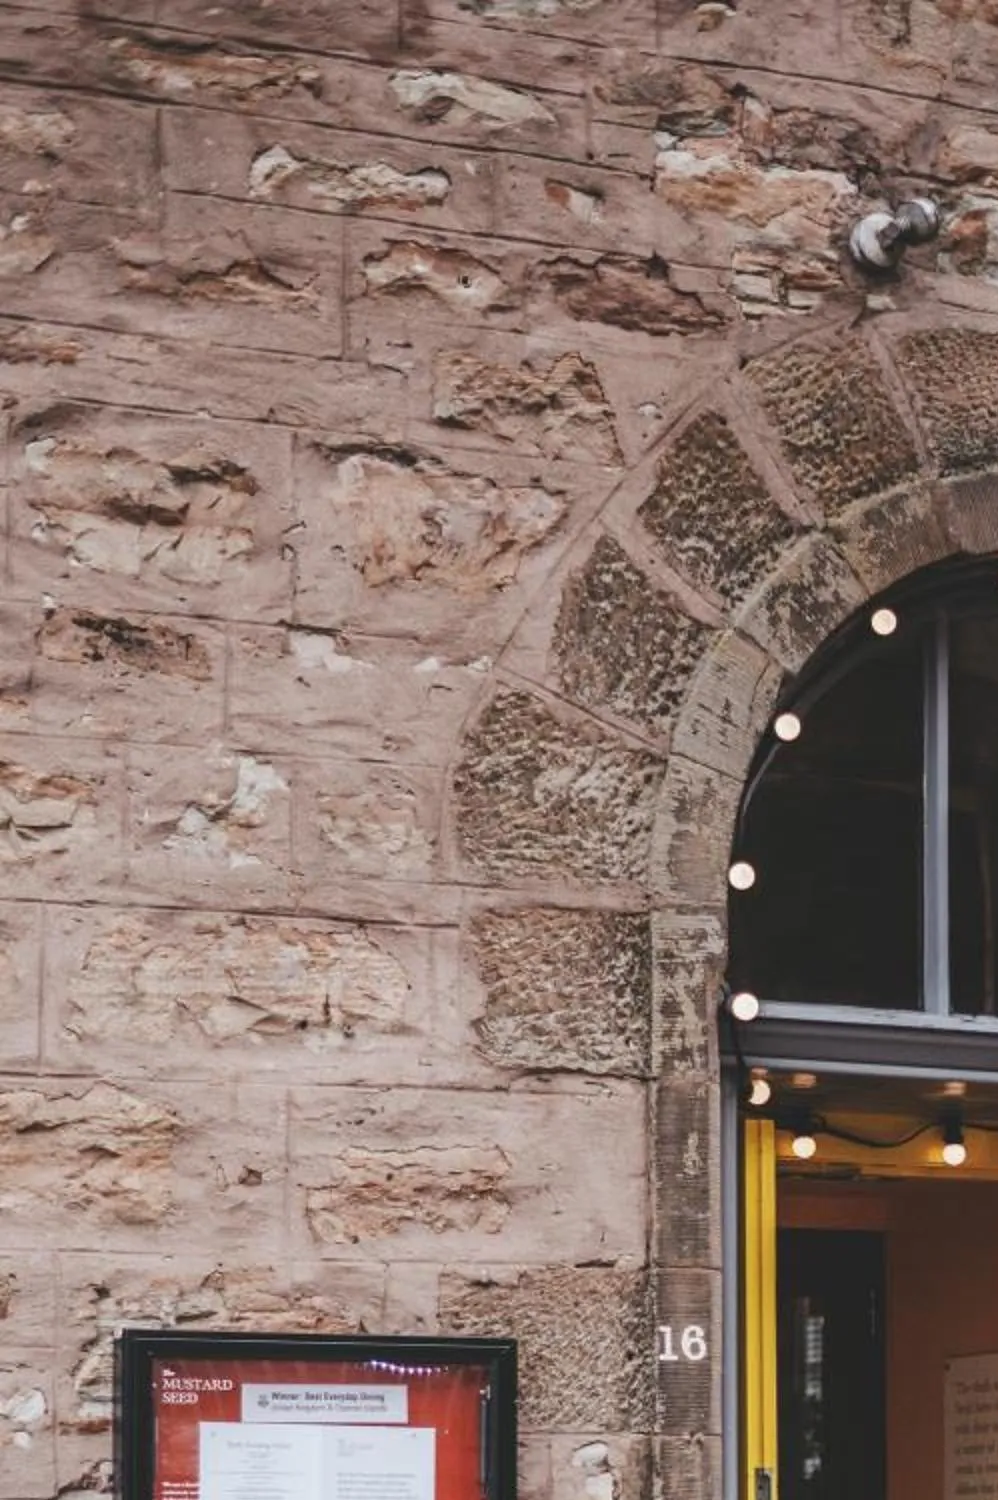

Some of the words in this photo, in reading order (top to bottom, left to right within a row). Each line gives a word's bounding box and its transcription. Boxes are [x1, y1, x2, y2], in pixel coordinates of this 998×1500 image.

[659, 1325, 707, 1361] 16
[162, 1378, 233, 1391] MUSTARD
[162, 1391, 199, 1404] SEED
